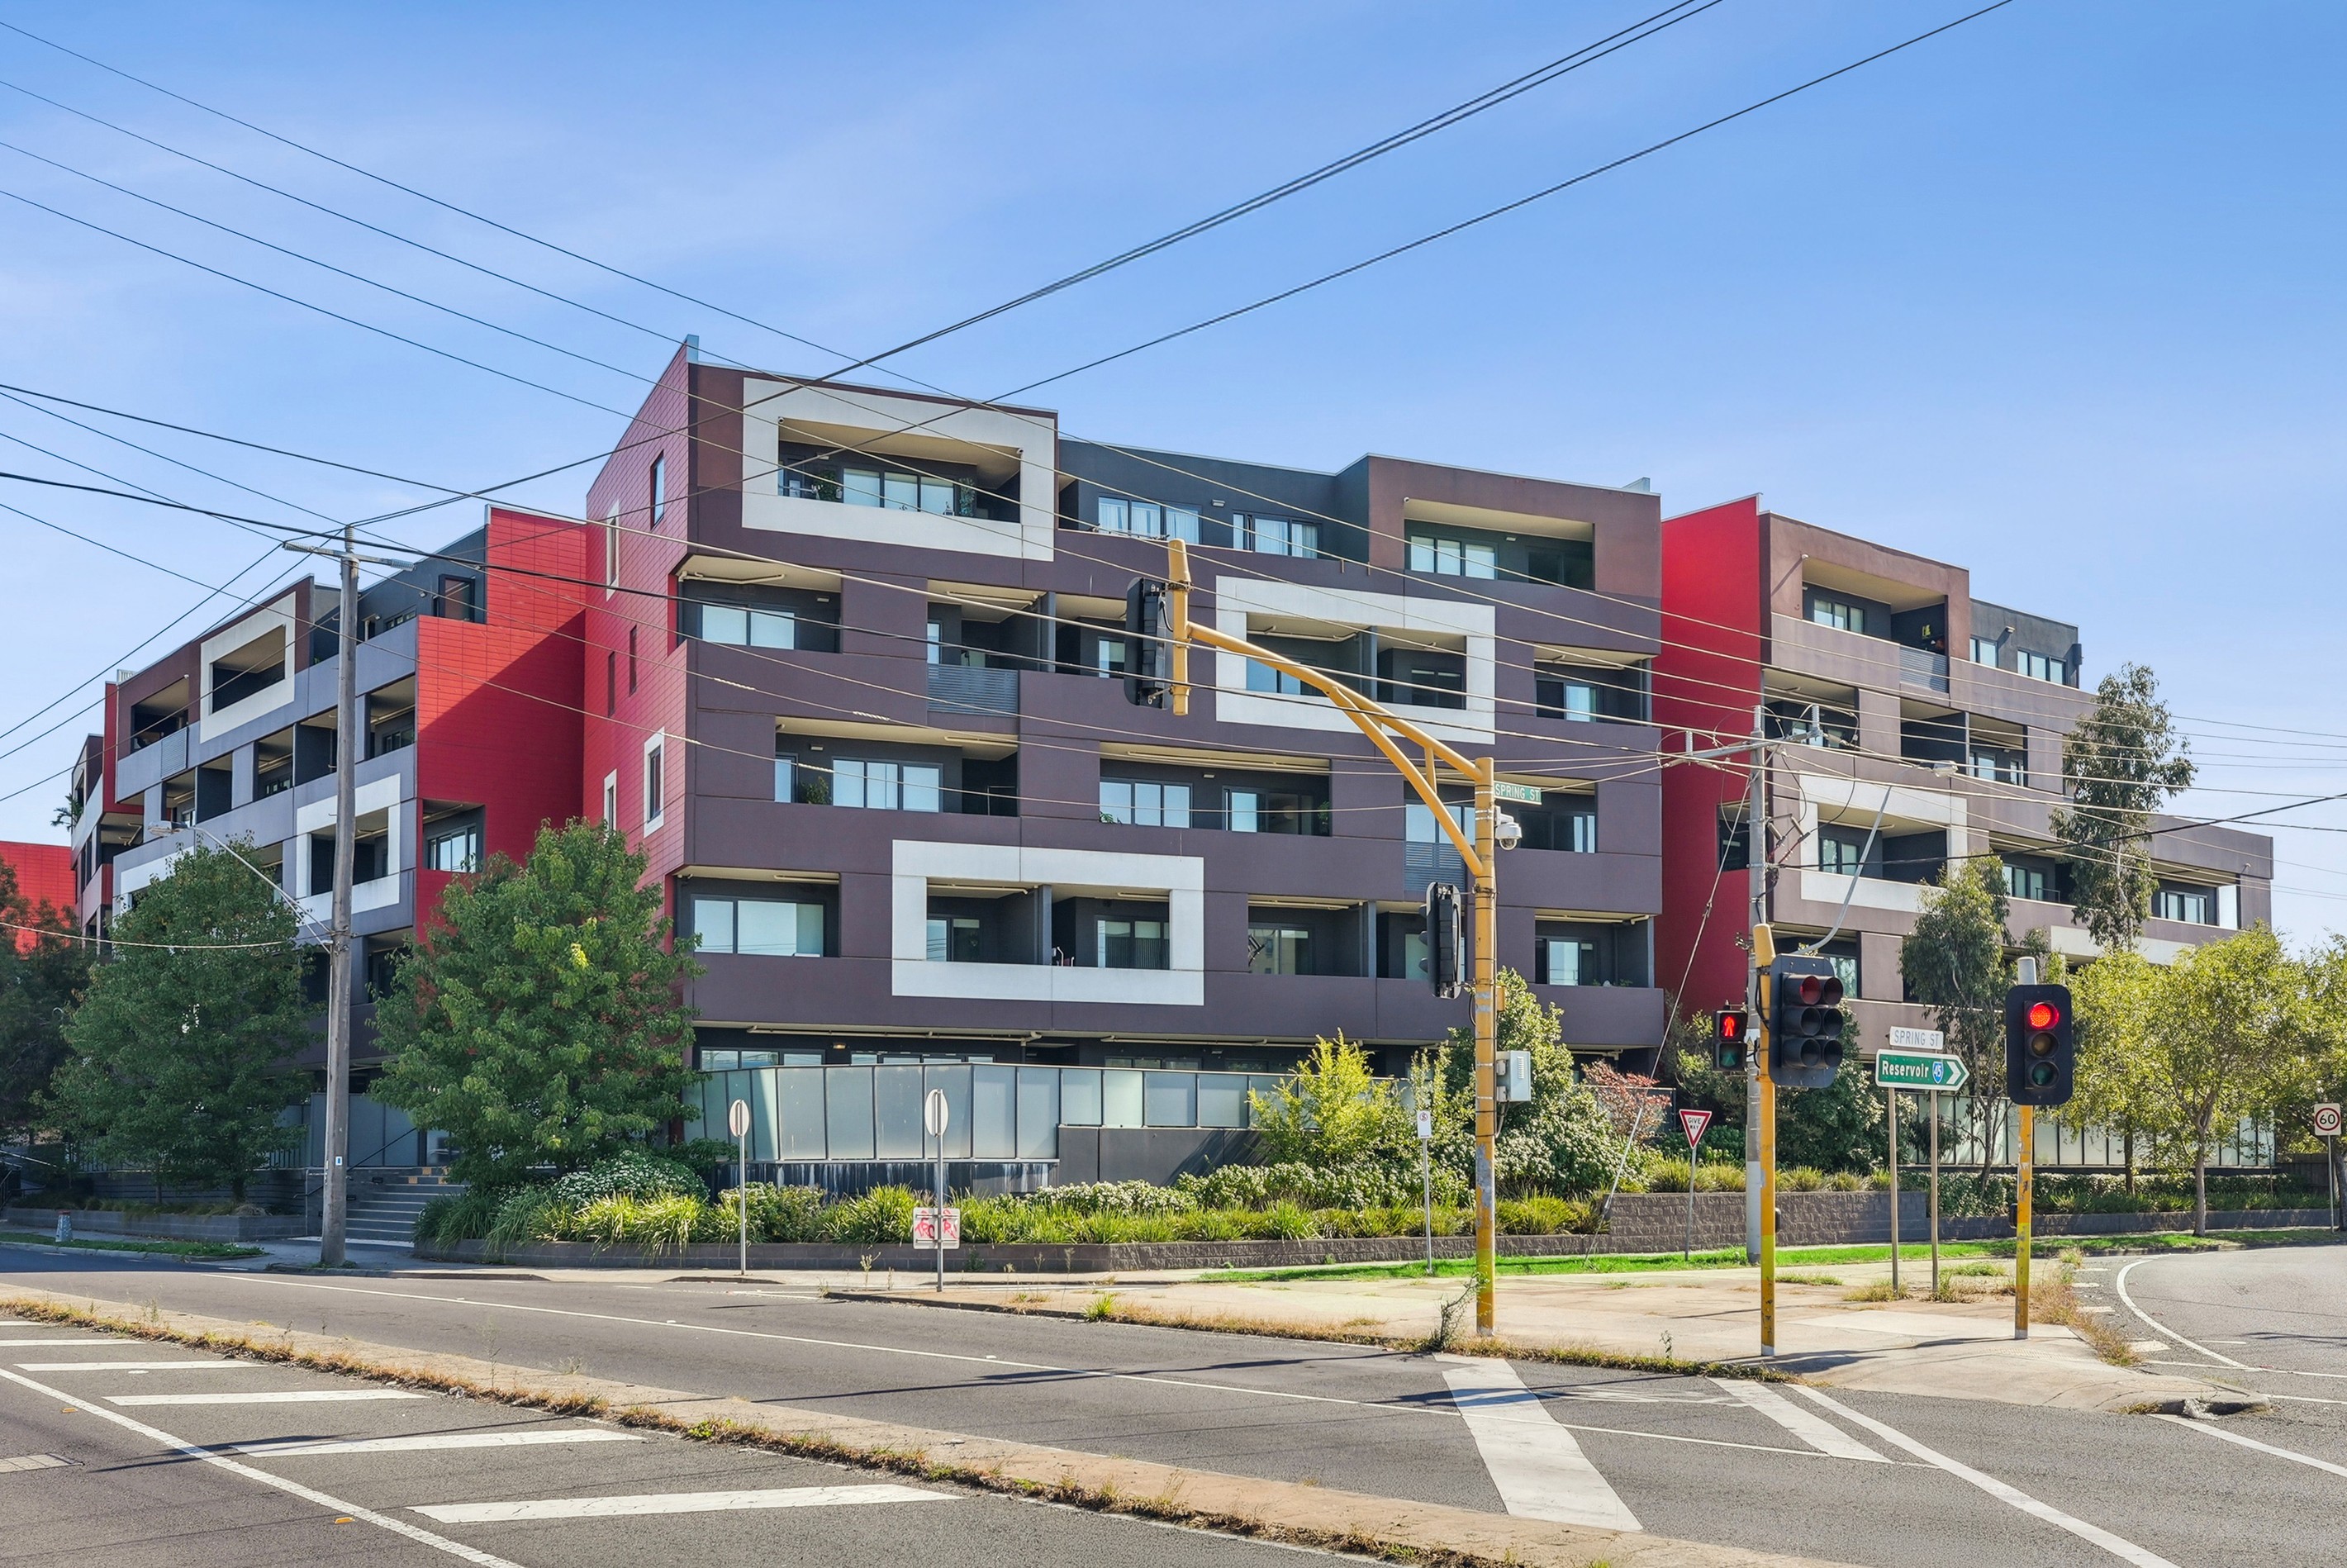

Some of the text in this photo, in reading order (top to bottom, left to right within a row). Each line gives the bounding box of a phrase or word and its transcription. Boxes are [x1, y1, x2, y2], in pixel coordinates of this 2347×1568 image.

[1495, 783, 1541, 801] SPRING ST
[1894, 1029, 1940, 1047] SPRING ST
[1882, 1060, 1941, 1078] Reservoir 45
[2320, 1114, 2335, 1124] 60
